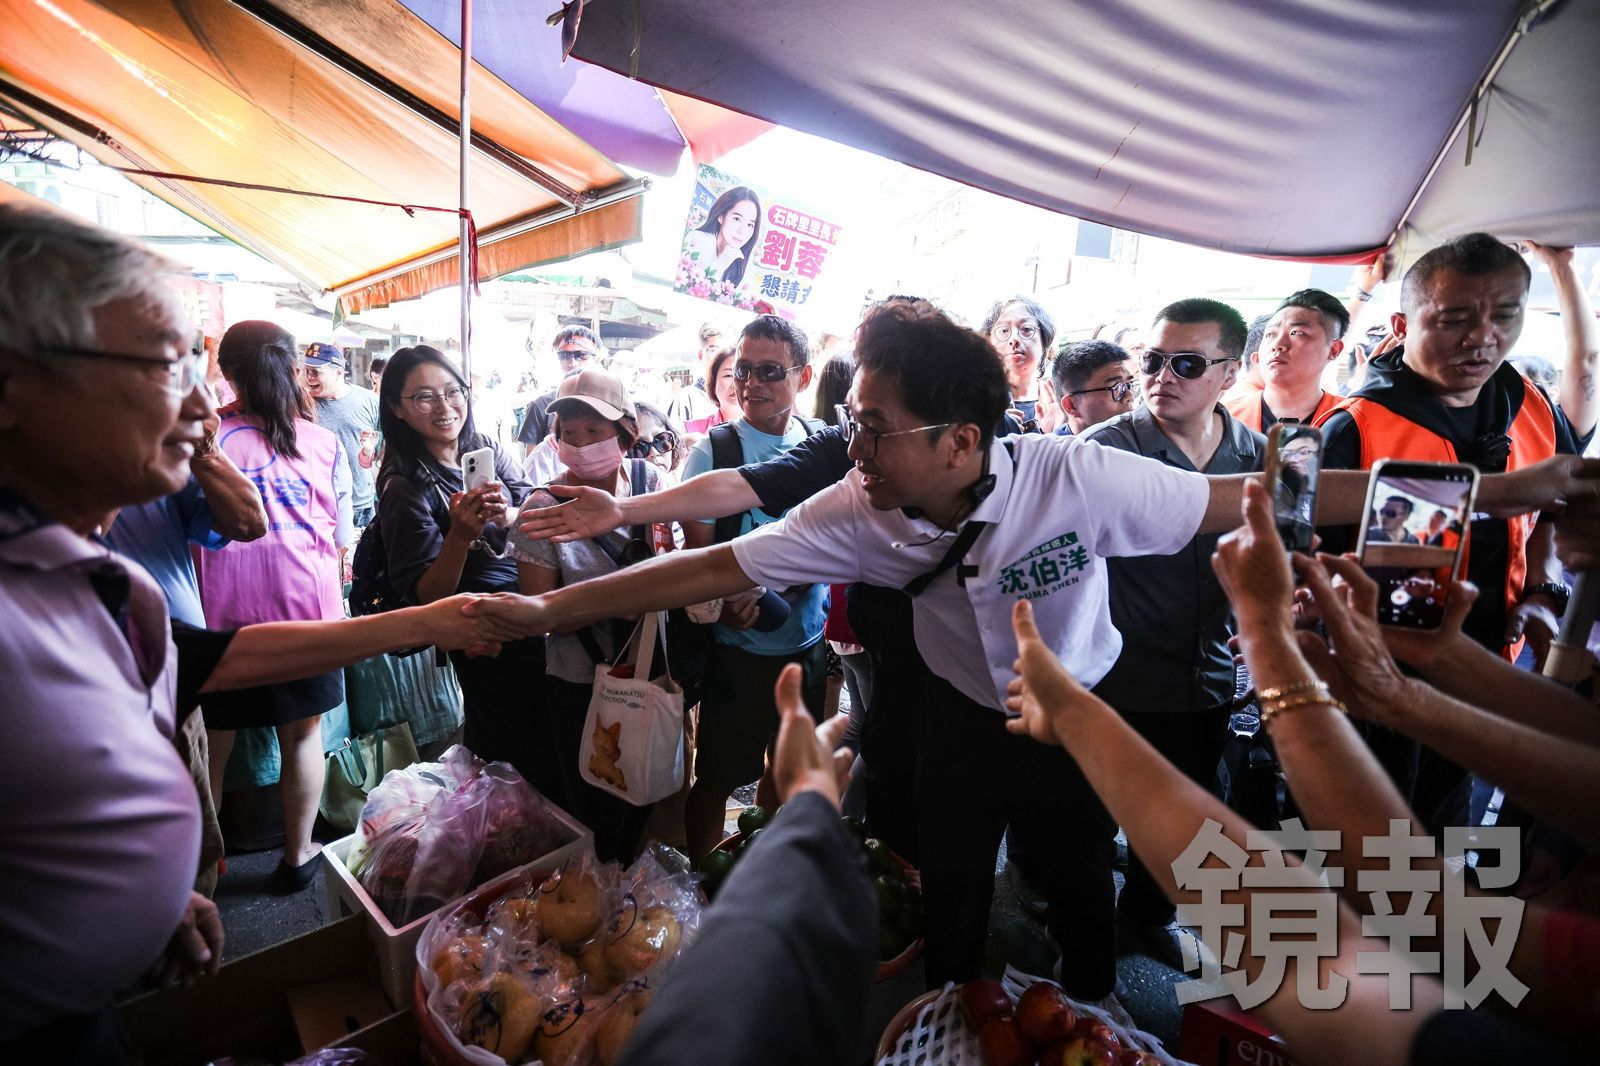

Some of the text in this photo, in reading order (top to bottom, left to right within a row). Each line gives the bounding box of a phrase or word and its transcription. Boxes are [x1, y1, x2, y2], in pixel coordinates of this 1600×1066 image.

[773, 206, 833, 242] 石牌里里長
[760, 230, 828, 279] 劉蓉
[998, 545, 1090, 594] 沈伯洋
[1051, 576, 1080, 593] SHEN
